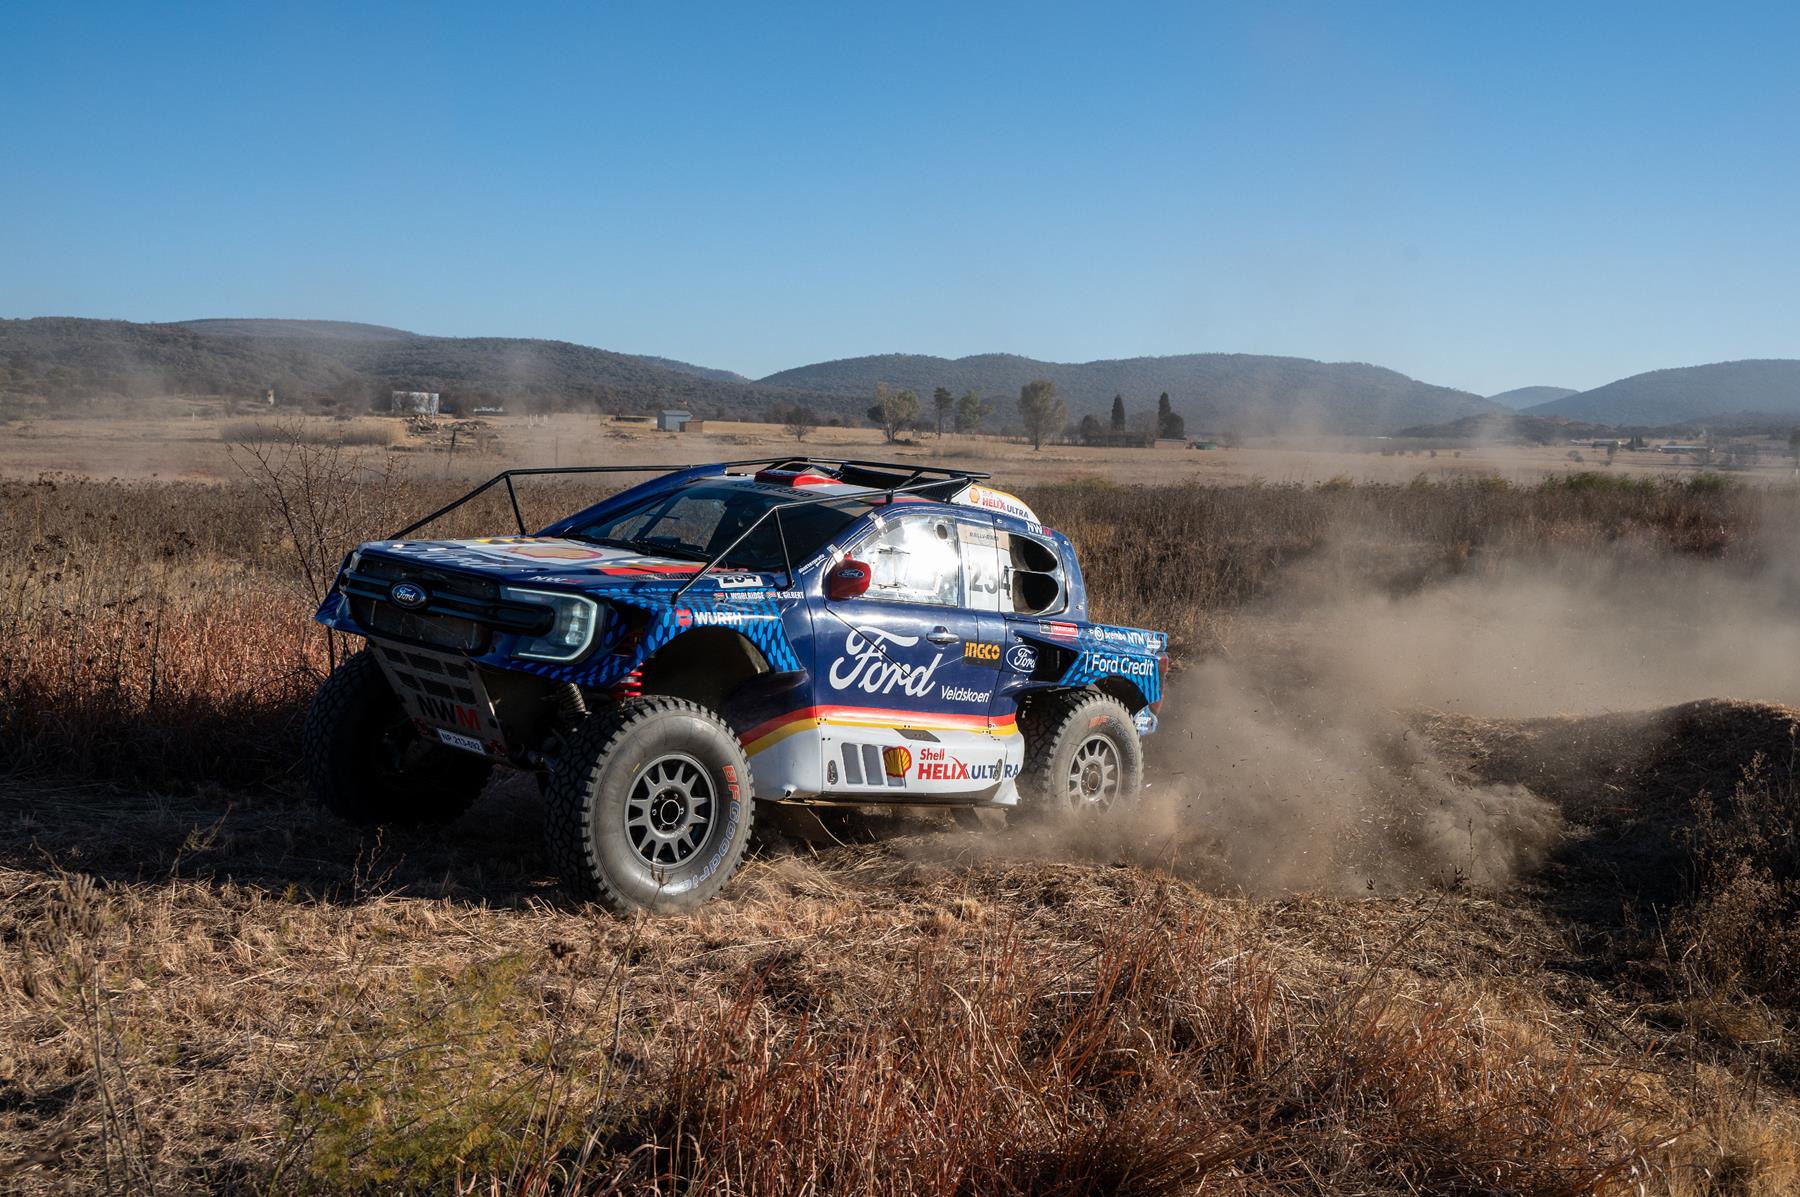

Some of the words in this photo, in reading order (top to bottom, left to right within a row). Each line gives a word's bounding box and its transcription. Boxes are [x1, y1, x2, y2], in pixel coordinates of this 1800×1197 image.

[982, 496, 1006, 511] HELIX
[1006, 503, 1029, 519] ULTRA
[1026, 520, 1052, 538] NWM
[841, 569, 860, 578] Ford
[396, 586, 417, 601] Ford
[1104, 630, 1126, 641] brembo
[1127, 632, 1145, 645] NTN
[829, 625, 943, 697] Ford
[1014, 647, 1036, 668] Ford
[1091, 654, 1118, 673] Ford
[1120, 657, 1154, 676] Credit
[941, 685, 991, 703] Veldskoen
[416, 693, 481, 732] NWM
[919, 748, 945, 761] Shell
[917, 757, 970, 780] HELIX
[971, 764, 1019, 780] ULTRA
